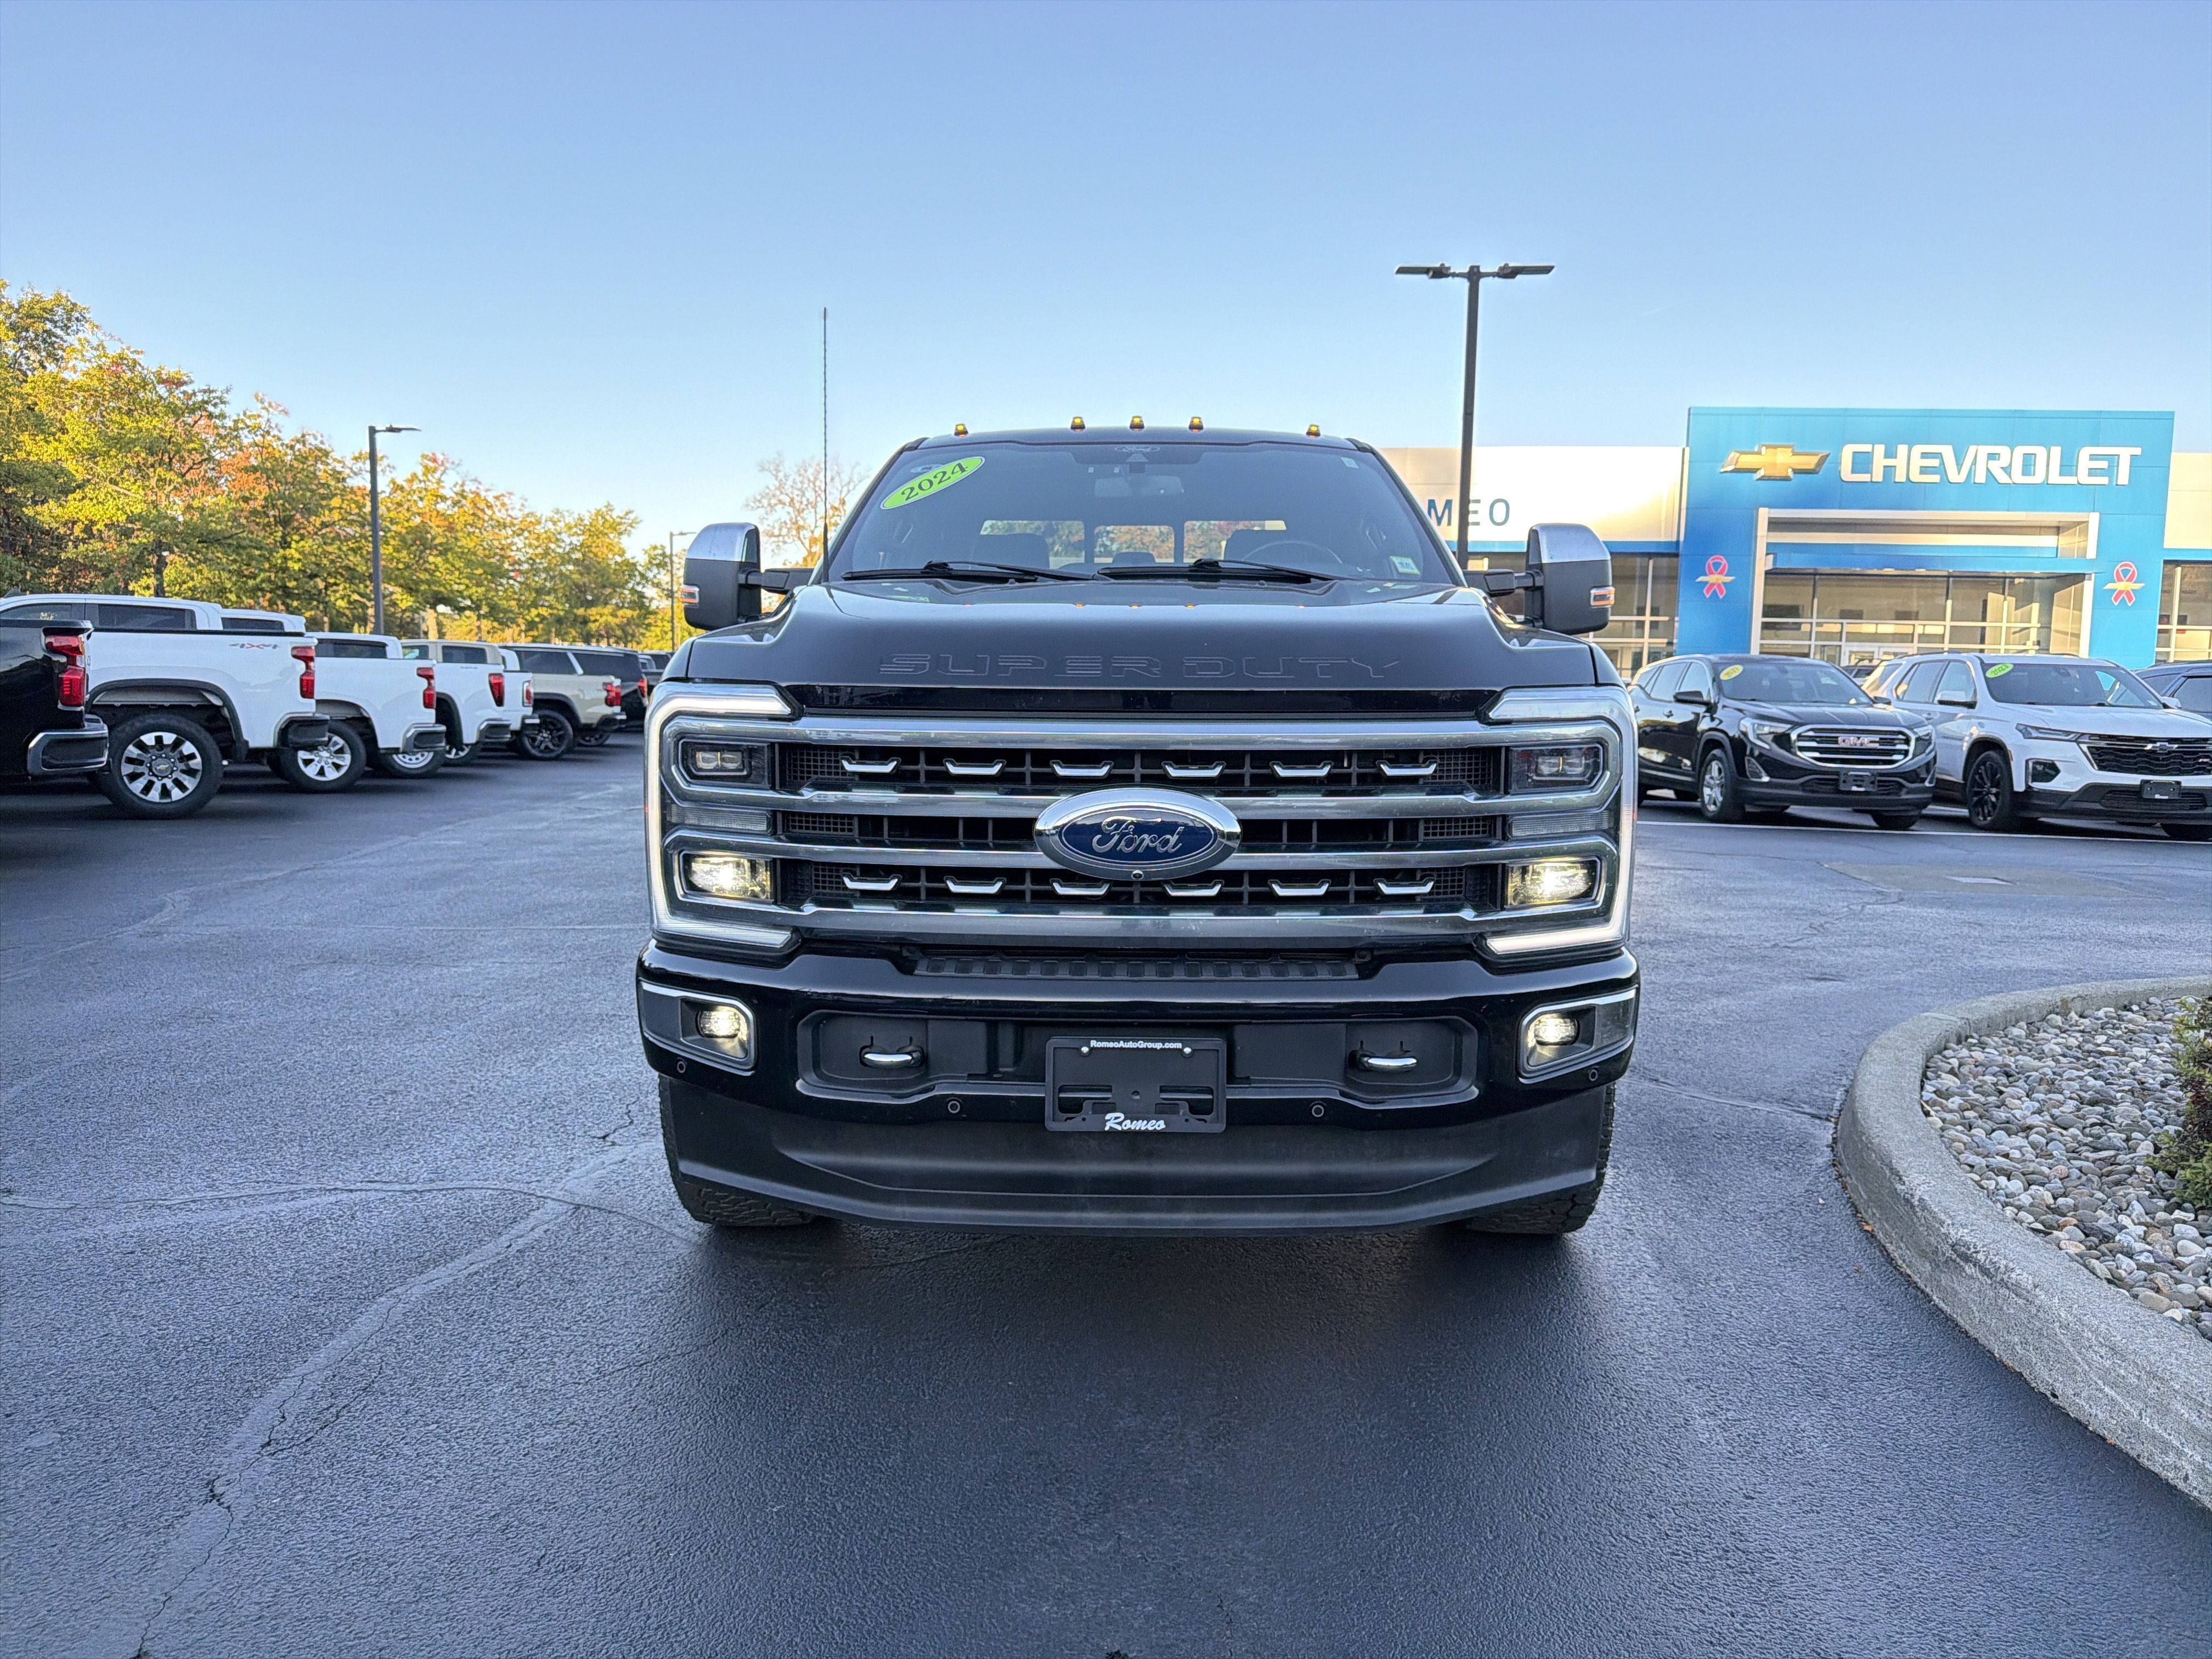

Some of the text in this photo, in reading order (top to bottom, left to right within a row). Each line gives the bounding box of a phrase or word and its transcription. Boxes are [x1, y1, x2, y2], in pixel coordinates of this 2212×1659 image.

[1840, 443, 2142, 486] CHEVROLET
[901, 462, 969, 501] 2024
[879, 654, 1400, 679] SUPER DUTY
[1837, 736, 1880, 748] GMC
[1092, 816, 1186, 854] Ford
[1090, 1040, 1182, 1050] RomeoAutoGroup.com
[1104, 1112, 1166, 1131] Romeo
